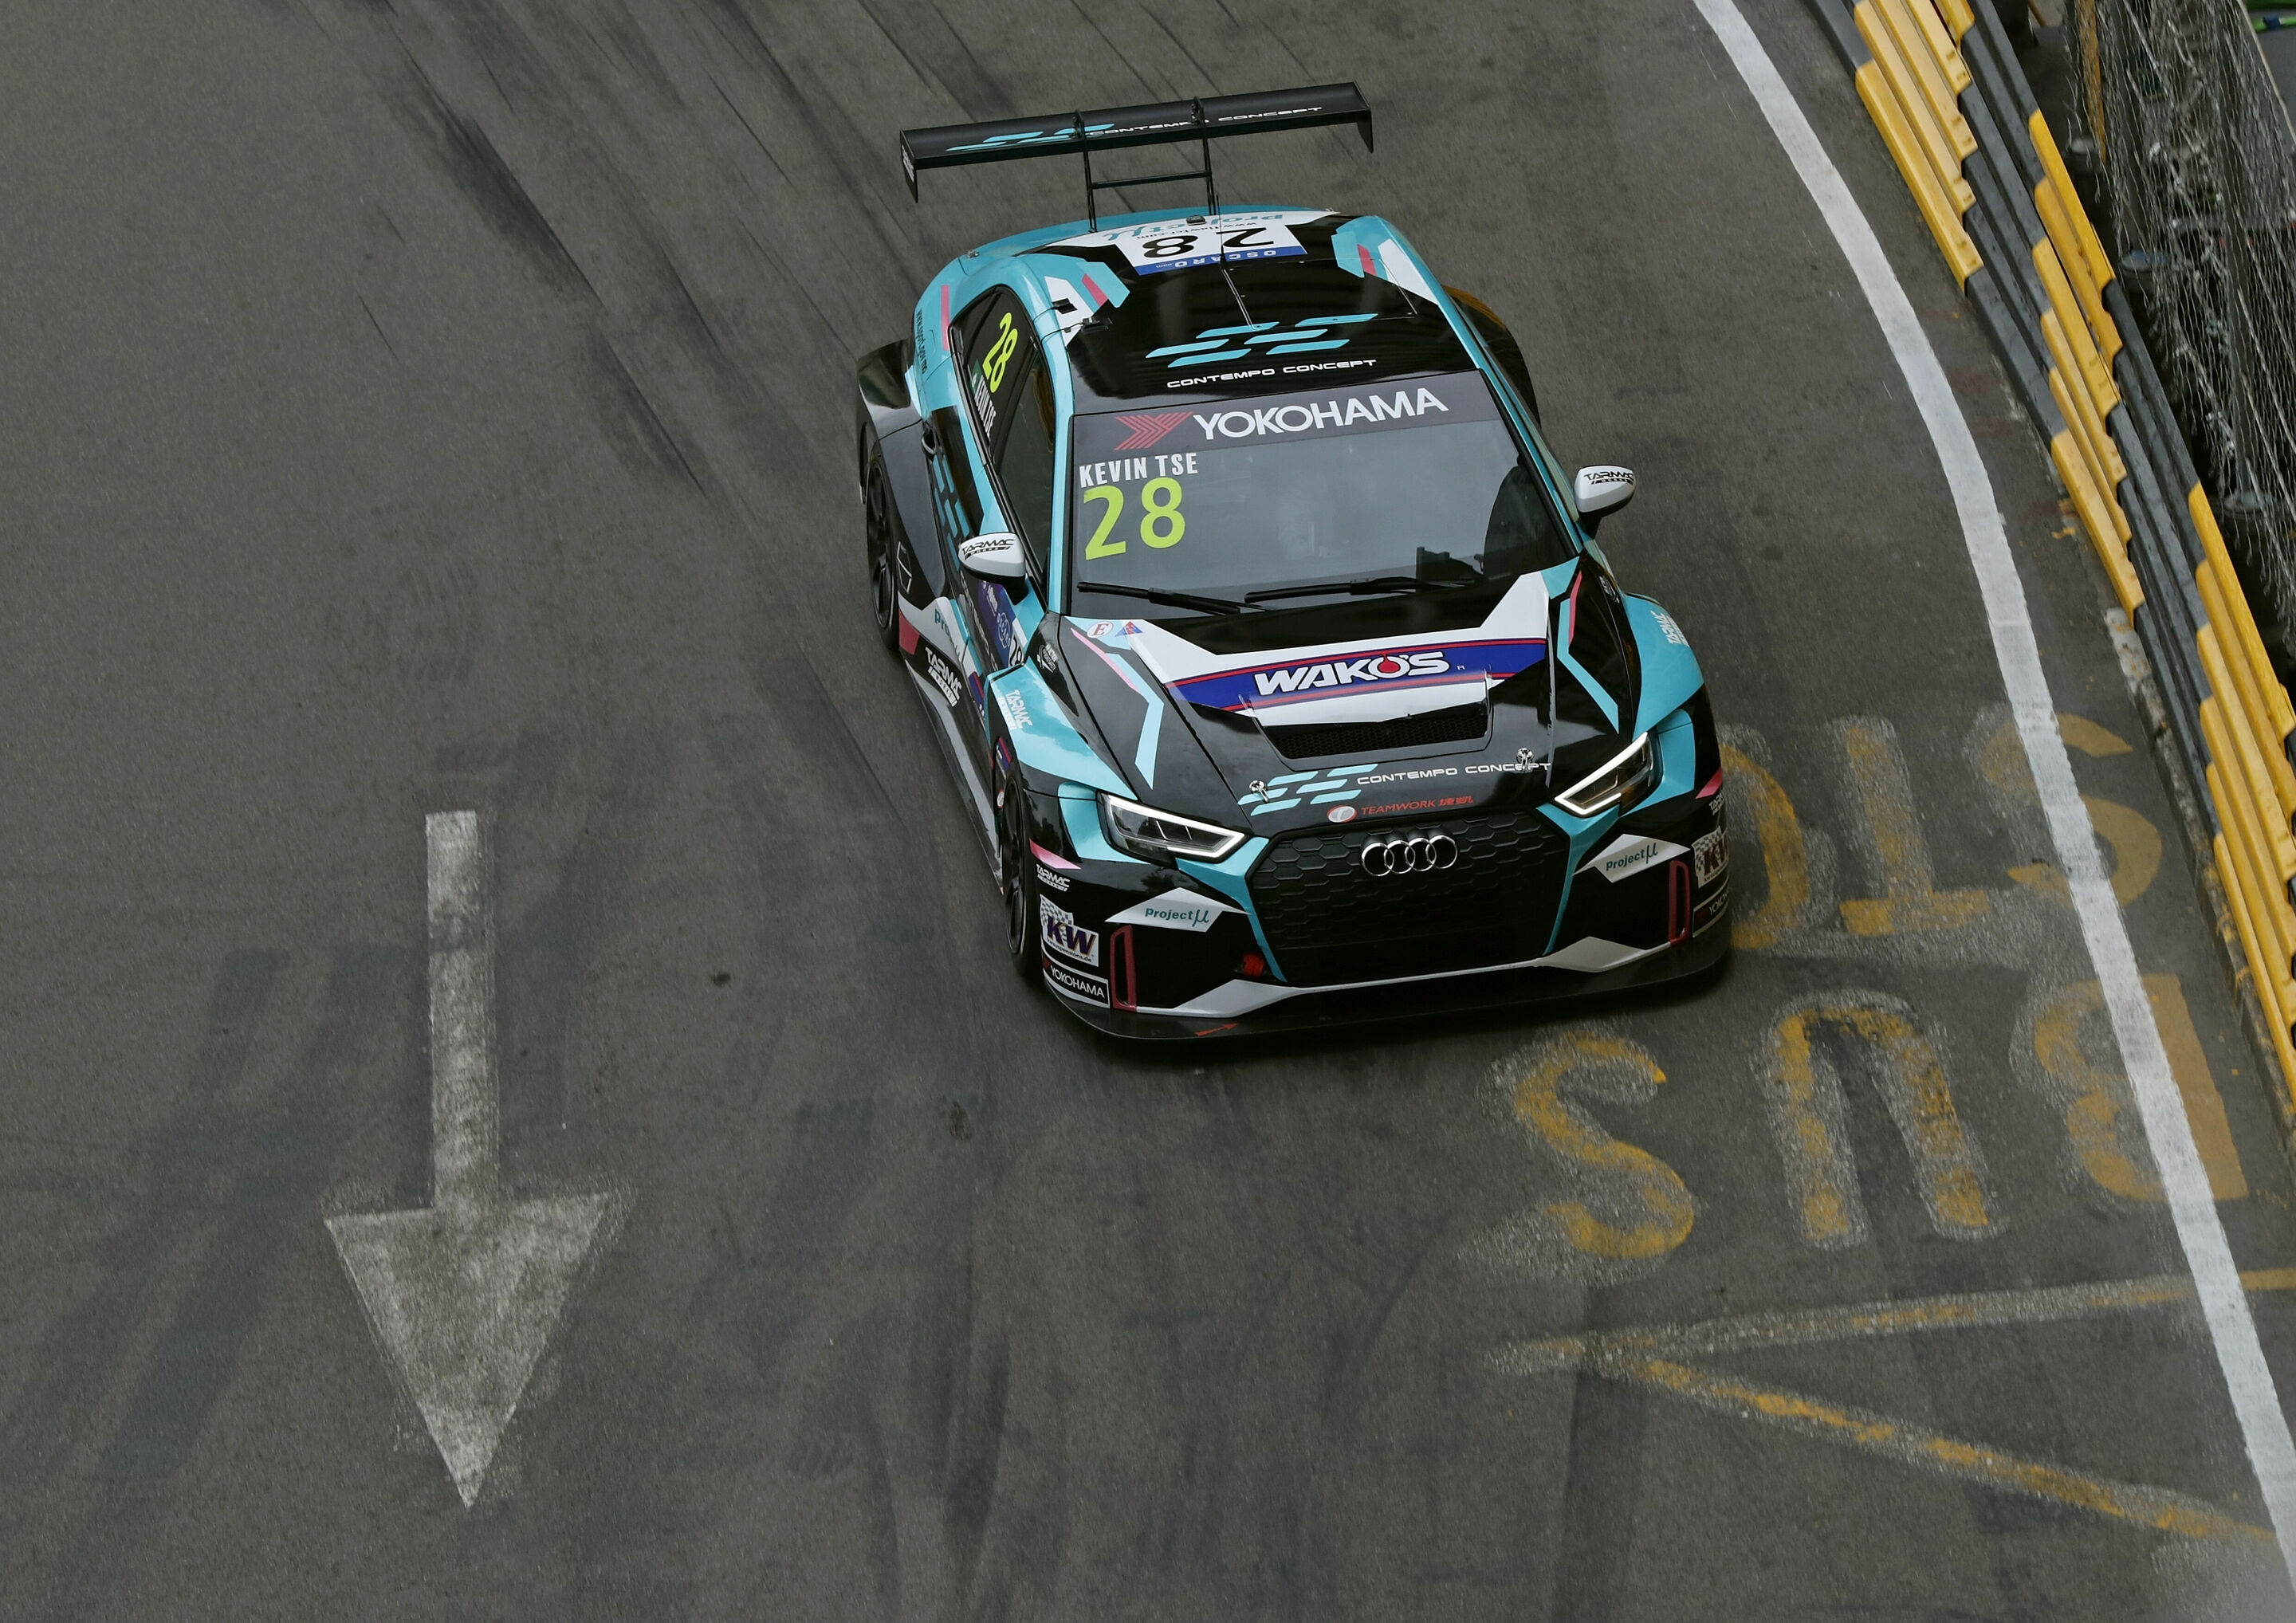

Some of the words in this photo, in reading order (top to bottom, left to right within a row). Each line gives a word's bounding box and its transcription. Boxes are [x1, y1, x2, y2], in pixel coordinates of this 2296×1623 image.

[1218, 107, 1322, 121] CONCEPT
[1142, 226, 1275, 258] 28
[982, 312, 1018, 394] 28
[1166, 367, 1275, 388] CONTEMPO
[1283, 359, 1377, 374] CONCEPT
[1193, 387, 1449, 441] YOKOHAMA
[1079, 457, 1147, 488] KEVIN
[1154, 452, 1198, 478] TSE
[1083, 477, 1186, 560] 28
[962, 539, 1015, 556] TARMAC
[1005, 690, 1033, 729] TARMAC
[1356, 765, 1458, 785] CONTEMPO
[1464, 763, 1551, 774] CONCEPT
[1361, 800, 1436, 815] TEAMWORK
[1036, 863, 1071, 888] TARMAC
[1047, 915, 1097, 957] KW
[1050, 965, 1105, 999] YOKOHAMA
[1512, 973, 2251, 1259] BUS
